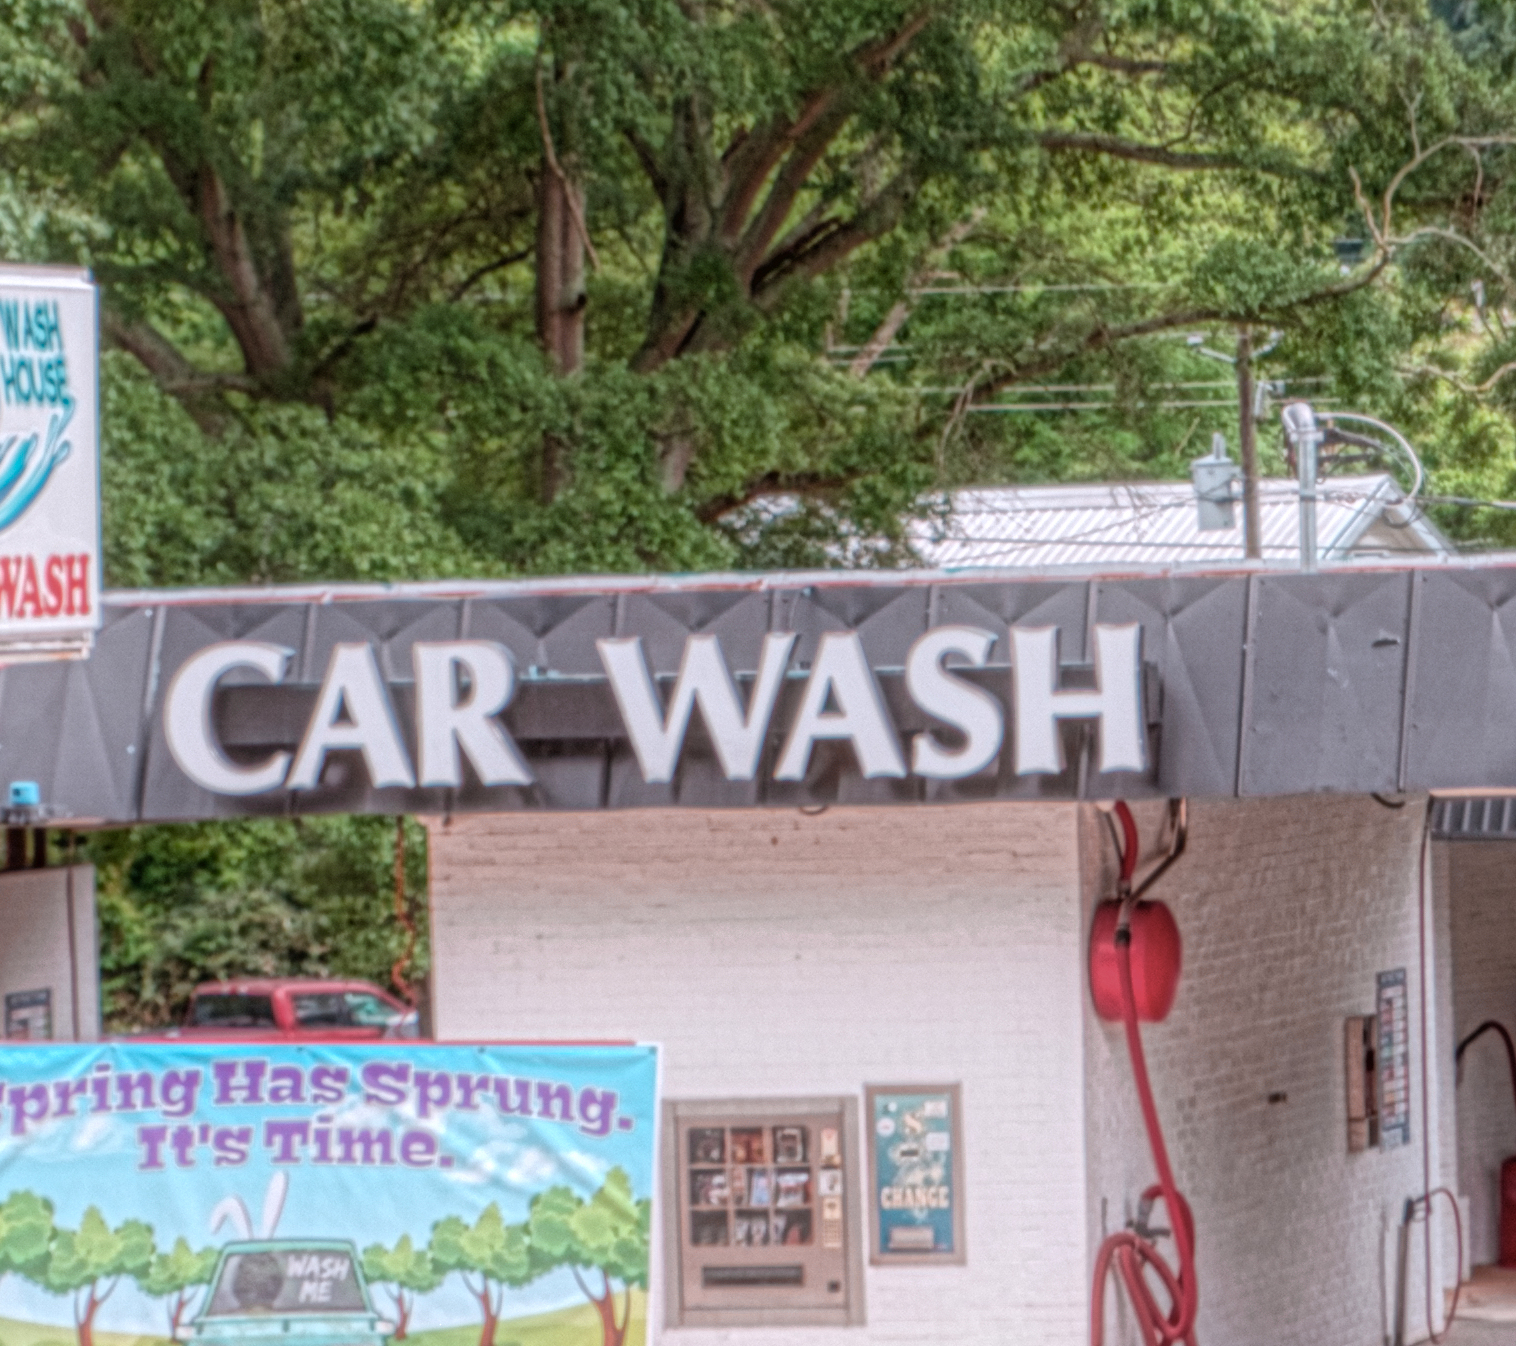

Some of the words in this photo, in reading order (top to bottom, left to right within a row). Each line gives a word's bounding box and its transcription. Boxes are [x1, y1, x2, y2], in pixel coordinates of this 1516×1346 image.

[0, 354, 68, 407] HOUSE
[163, 640, 533, 796] CAR
[595, 621, 1146, 784] WASH
[212, 1060, 350, 1105] Has
[360, 1061, 634, 1137] Sprung.
[137, 1124, 253, 1170] It's
[264, 1115, 455, 1168] Time.
[881, 1186, 950, 1209] CHANGE
[287, 1254, 351, 1282] WASH
[298, 1281, 333, 1303] ME
